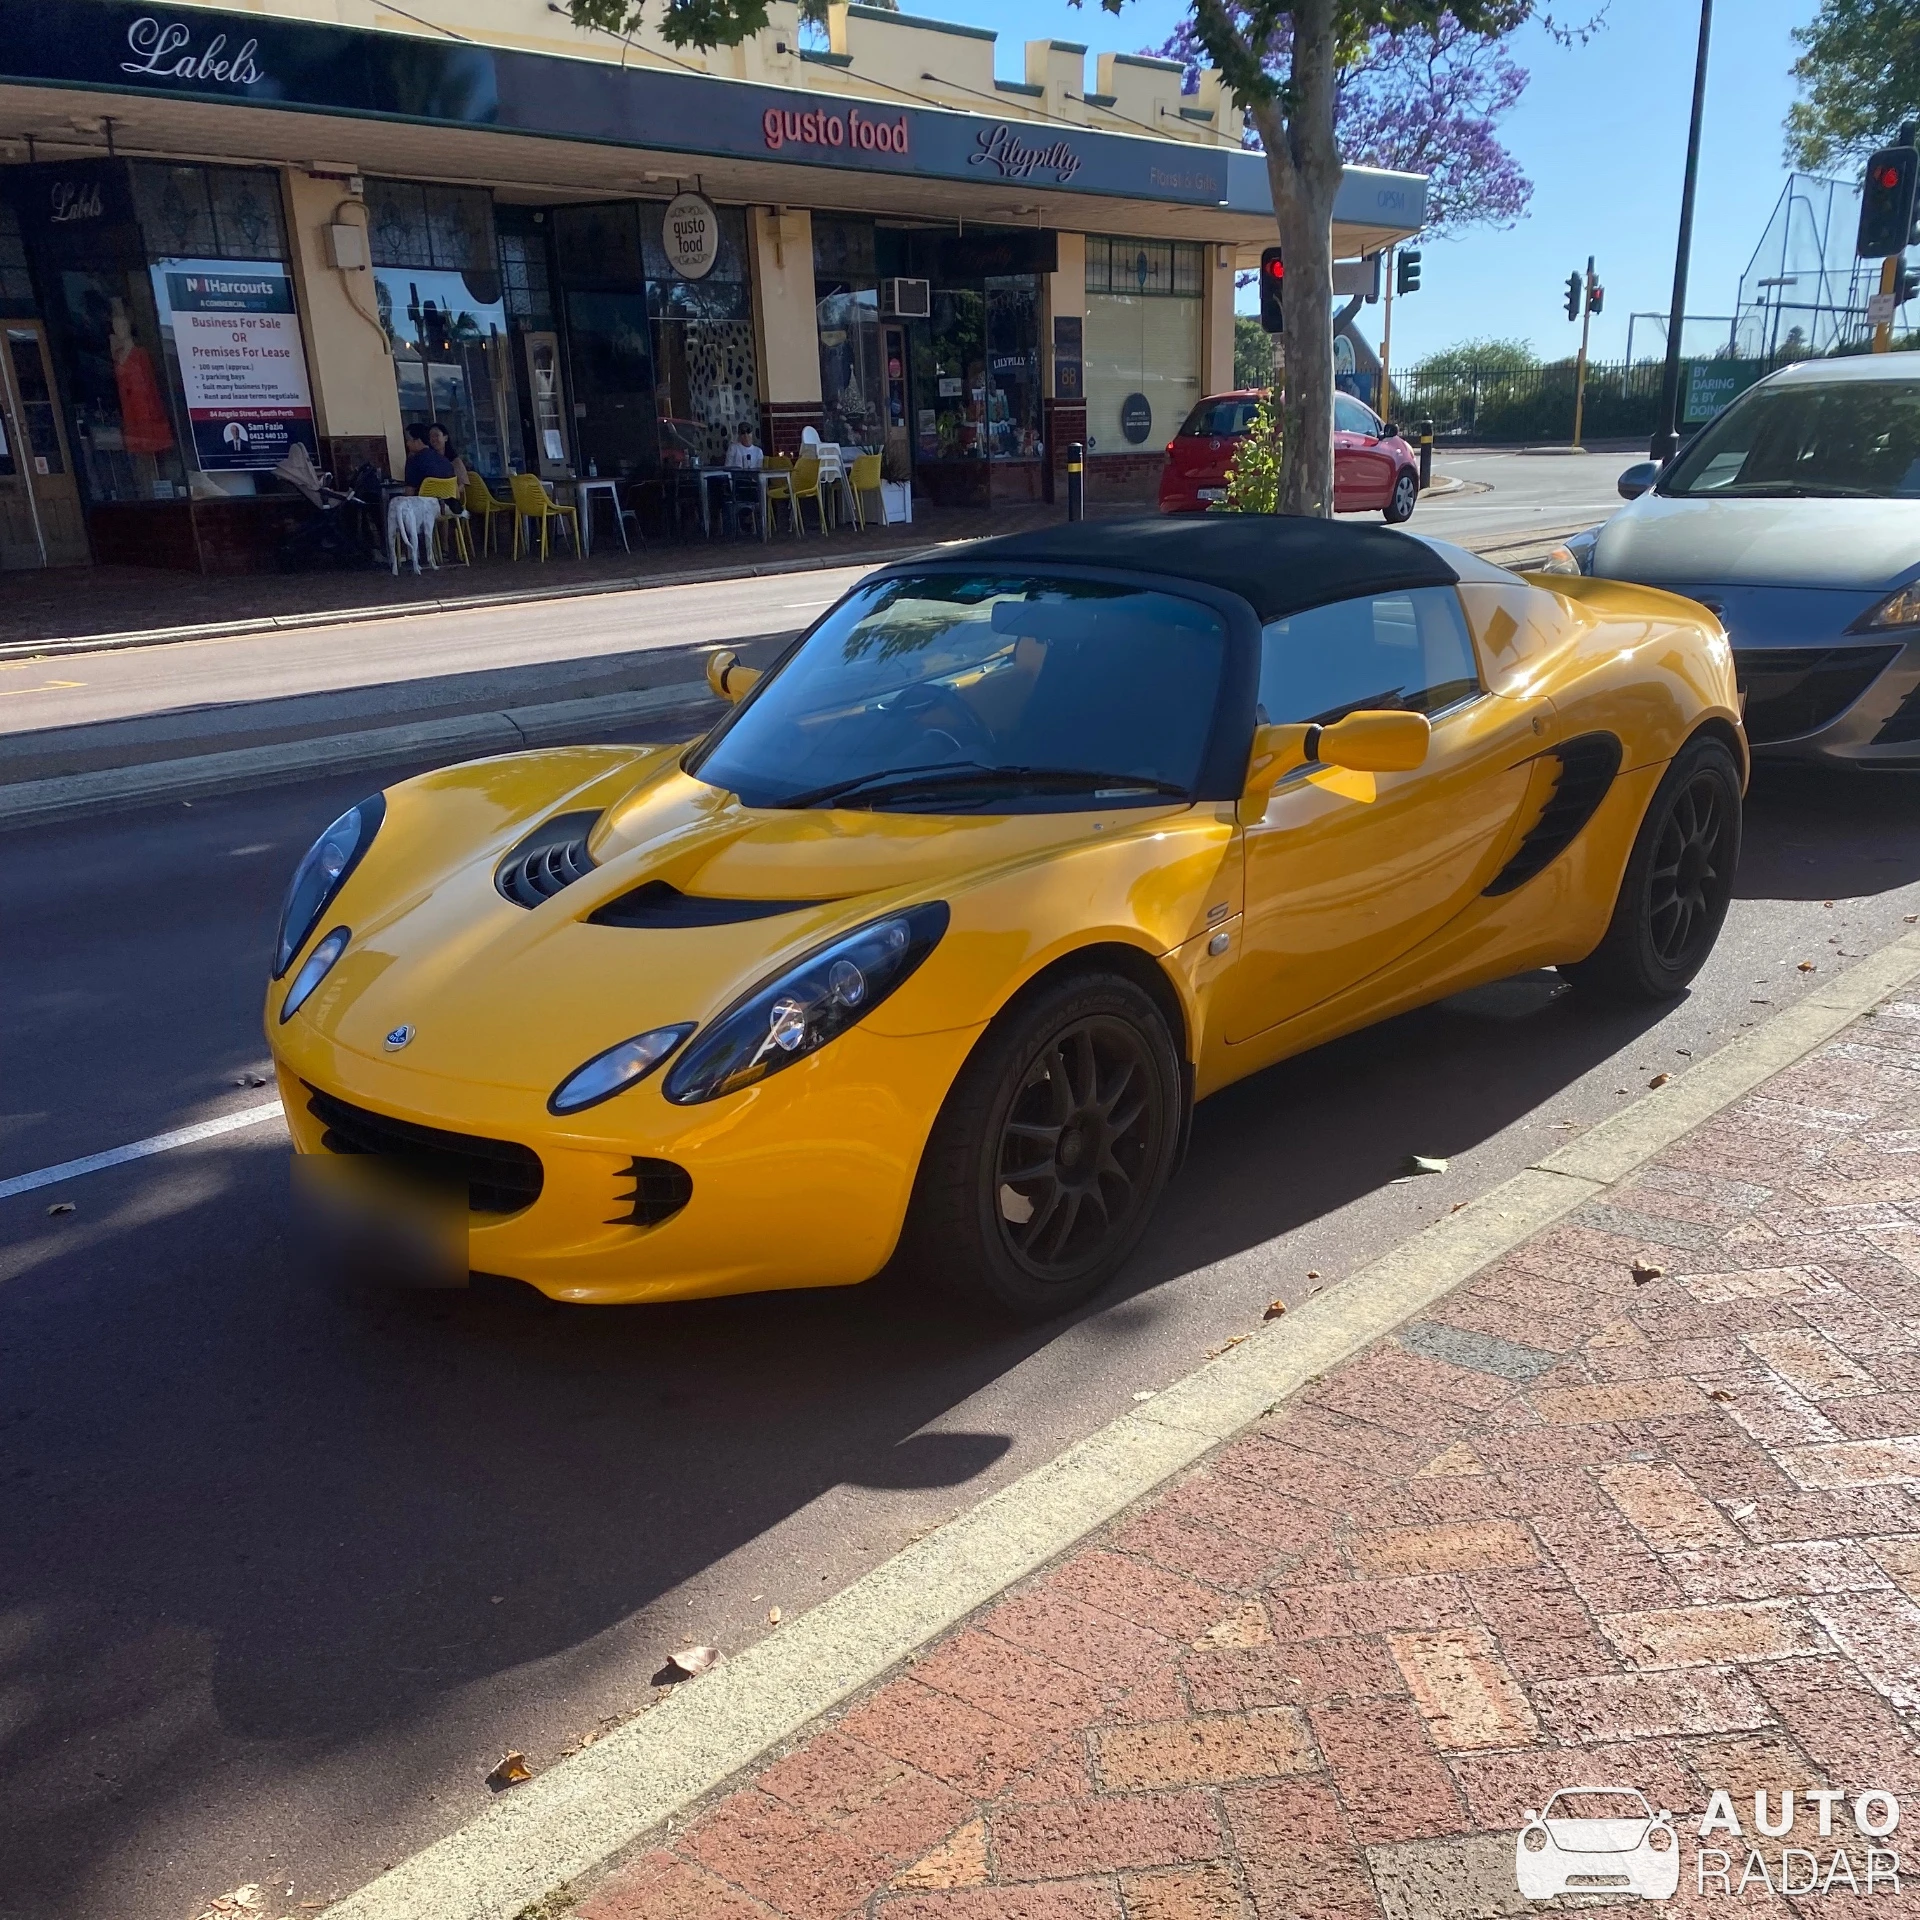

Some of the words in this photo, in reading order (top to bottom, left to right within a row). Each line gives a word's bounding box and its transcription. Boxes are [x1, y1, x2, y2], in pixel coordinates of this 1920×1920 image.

[120, 17, 265, 84] Labels
[763, 108, 845, 149] gusto
[848, 108, 909, 153] food
[969, 124, 1083, 183] Lilypilly
[673, 218, 705, 238] gusto
[679, 235, 703, 253] food
[210, 279, 274, 294] Harcourts
[192, 317, 238, 328] Business
[240, 318, 256, 328] For
[259, 318, 281, 329] Sale
[231, 332, 248, 342] OR
[192, 346, 240, 357] Premises
[243, 347, 259, 357] For
[261, 347, 290, 358] Lease
[1061, 367, 1077, 385] 88
[1693, 366, 1708, 378] BY
[261, 383, 278, 391] types
[1692, 378, 1735, 390] DARING
[1690, 392, 1699, 403] &
[1702, 391, 1717, 403] BY
[248, 423, 264, 431] Sam
